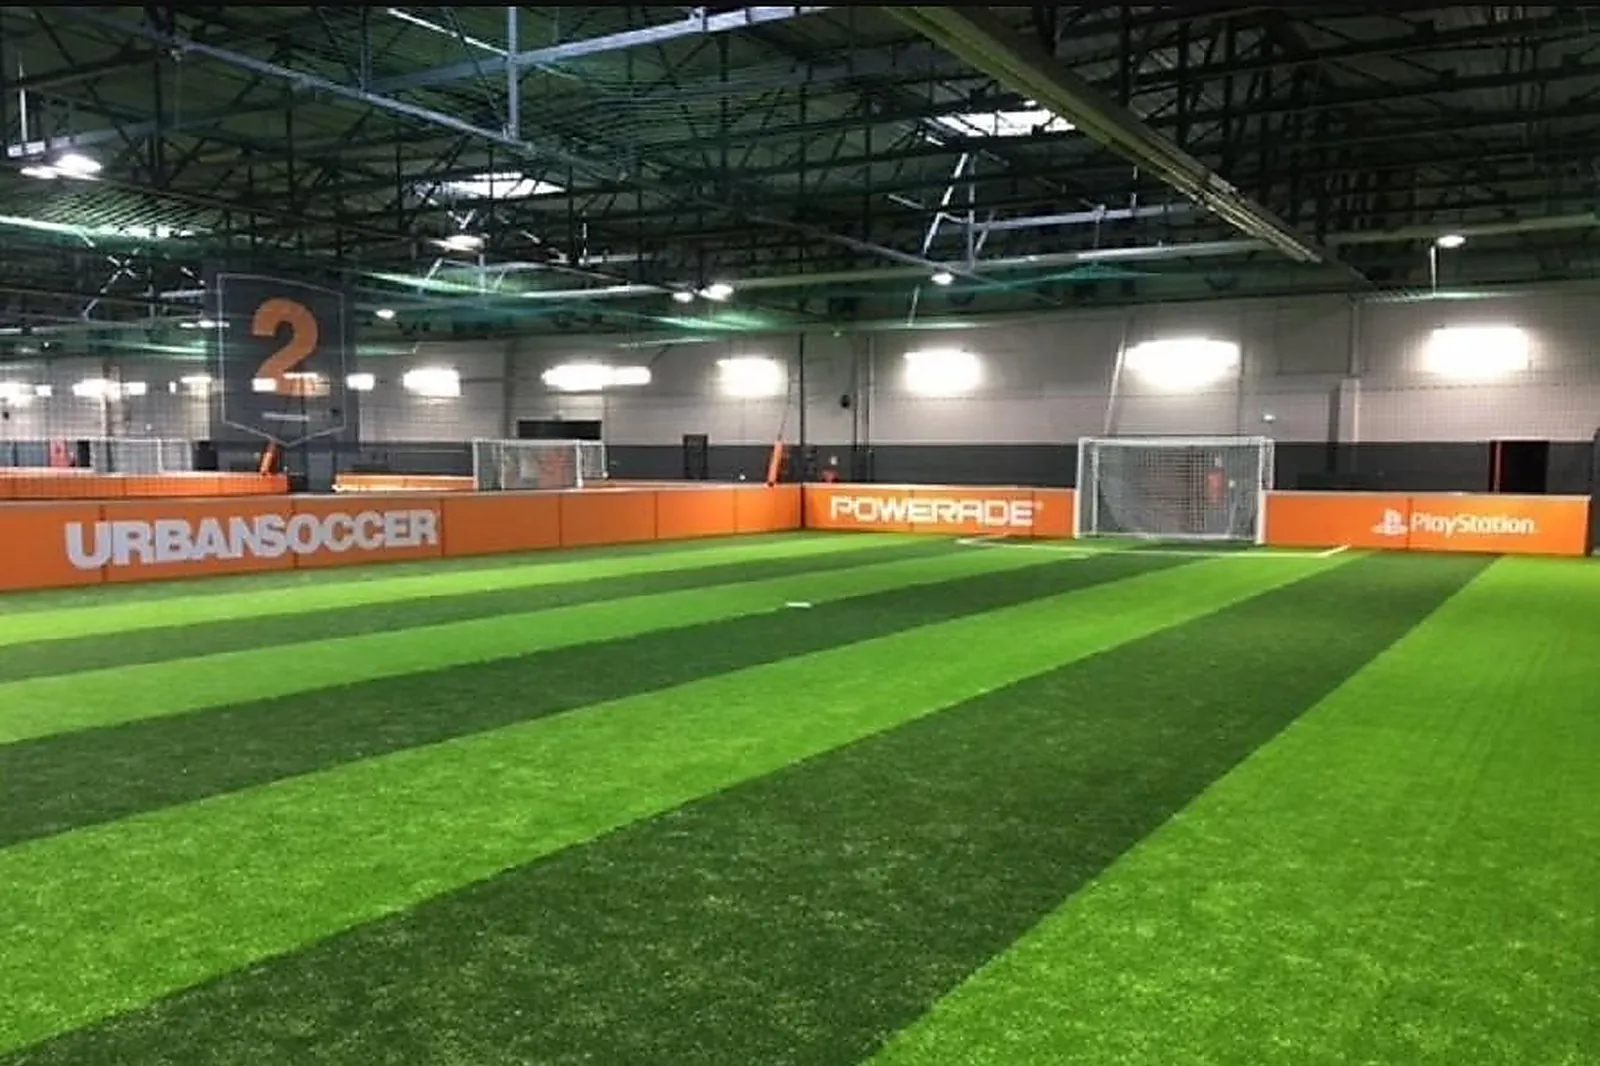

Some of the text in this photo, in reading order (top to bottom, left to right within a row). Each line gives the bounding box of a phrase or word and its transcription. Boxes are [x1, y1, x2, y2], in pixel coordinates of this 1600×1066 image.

[252, 298, 319, 396] 2
[831, 495, 1034, 527] POWERADE
[1411, 512, 1536, 538] PlayStation
[64, 508, 439, 570] URBANSOCCER
